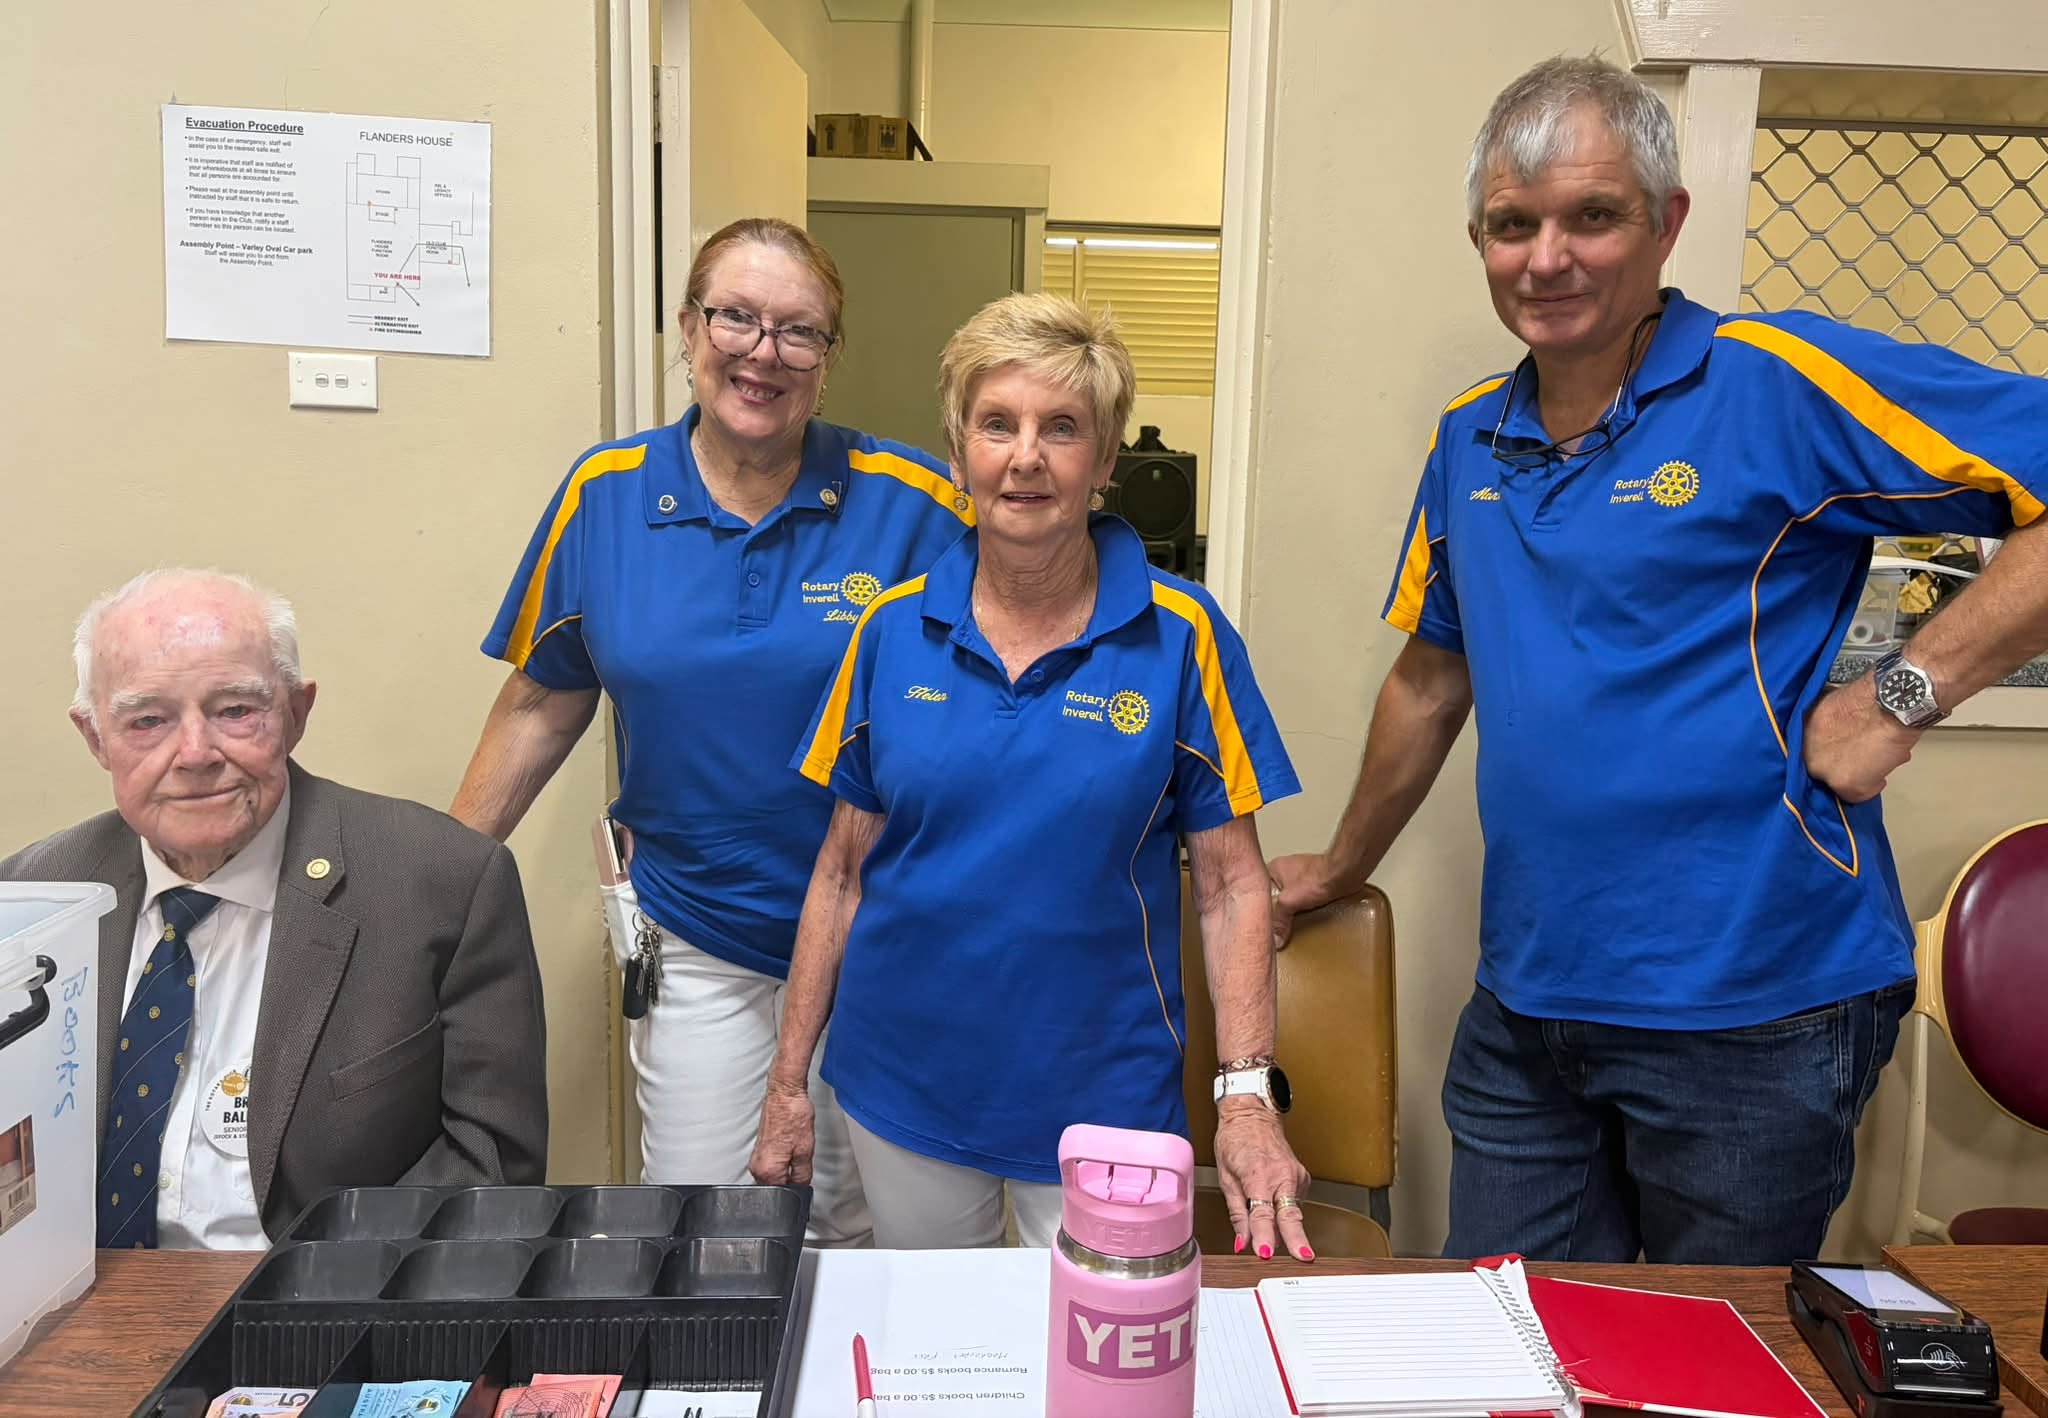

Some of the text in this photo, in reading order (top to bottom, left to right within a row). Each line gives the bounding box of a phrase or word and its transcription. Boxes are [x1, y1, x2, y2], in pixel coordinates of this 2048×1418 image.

[186, 117, 304, 133] Evacuation Procedure
[360, 131, 453, 146] FLANDERS HOUSE
[180, 240, 214, 249] Assembly
[242, 243, 264, 252] Varley
[1614, 478, 1650, 490] Rotary
[1610, 491, 1643, 504] Inverell
[802, 582, 840, 591] Rotary
[803, 593, 840, 603] Inverell
[824, 609, 859, 624] Libby
[1066, 690, 1107, 708] Rotary
[1062, 705, 1103, 722] Inverell
[1082, 1221, 1161, 1250] YETI
[278, 1392, 310, 1406] 5
[903, 1392, 936, 1401] $5.00
